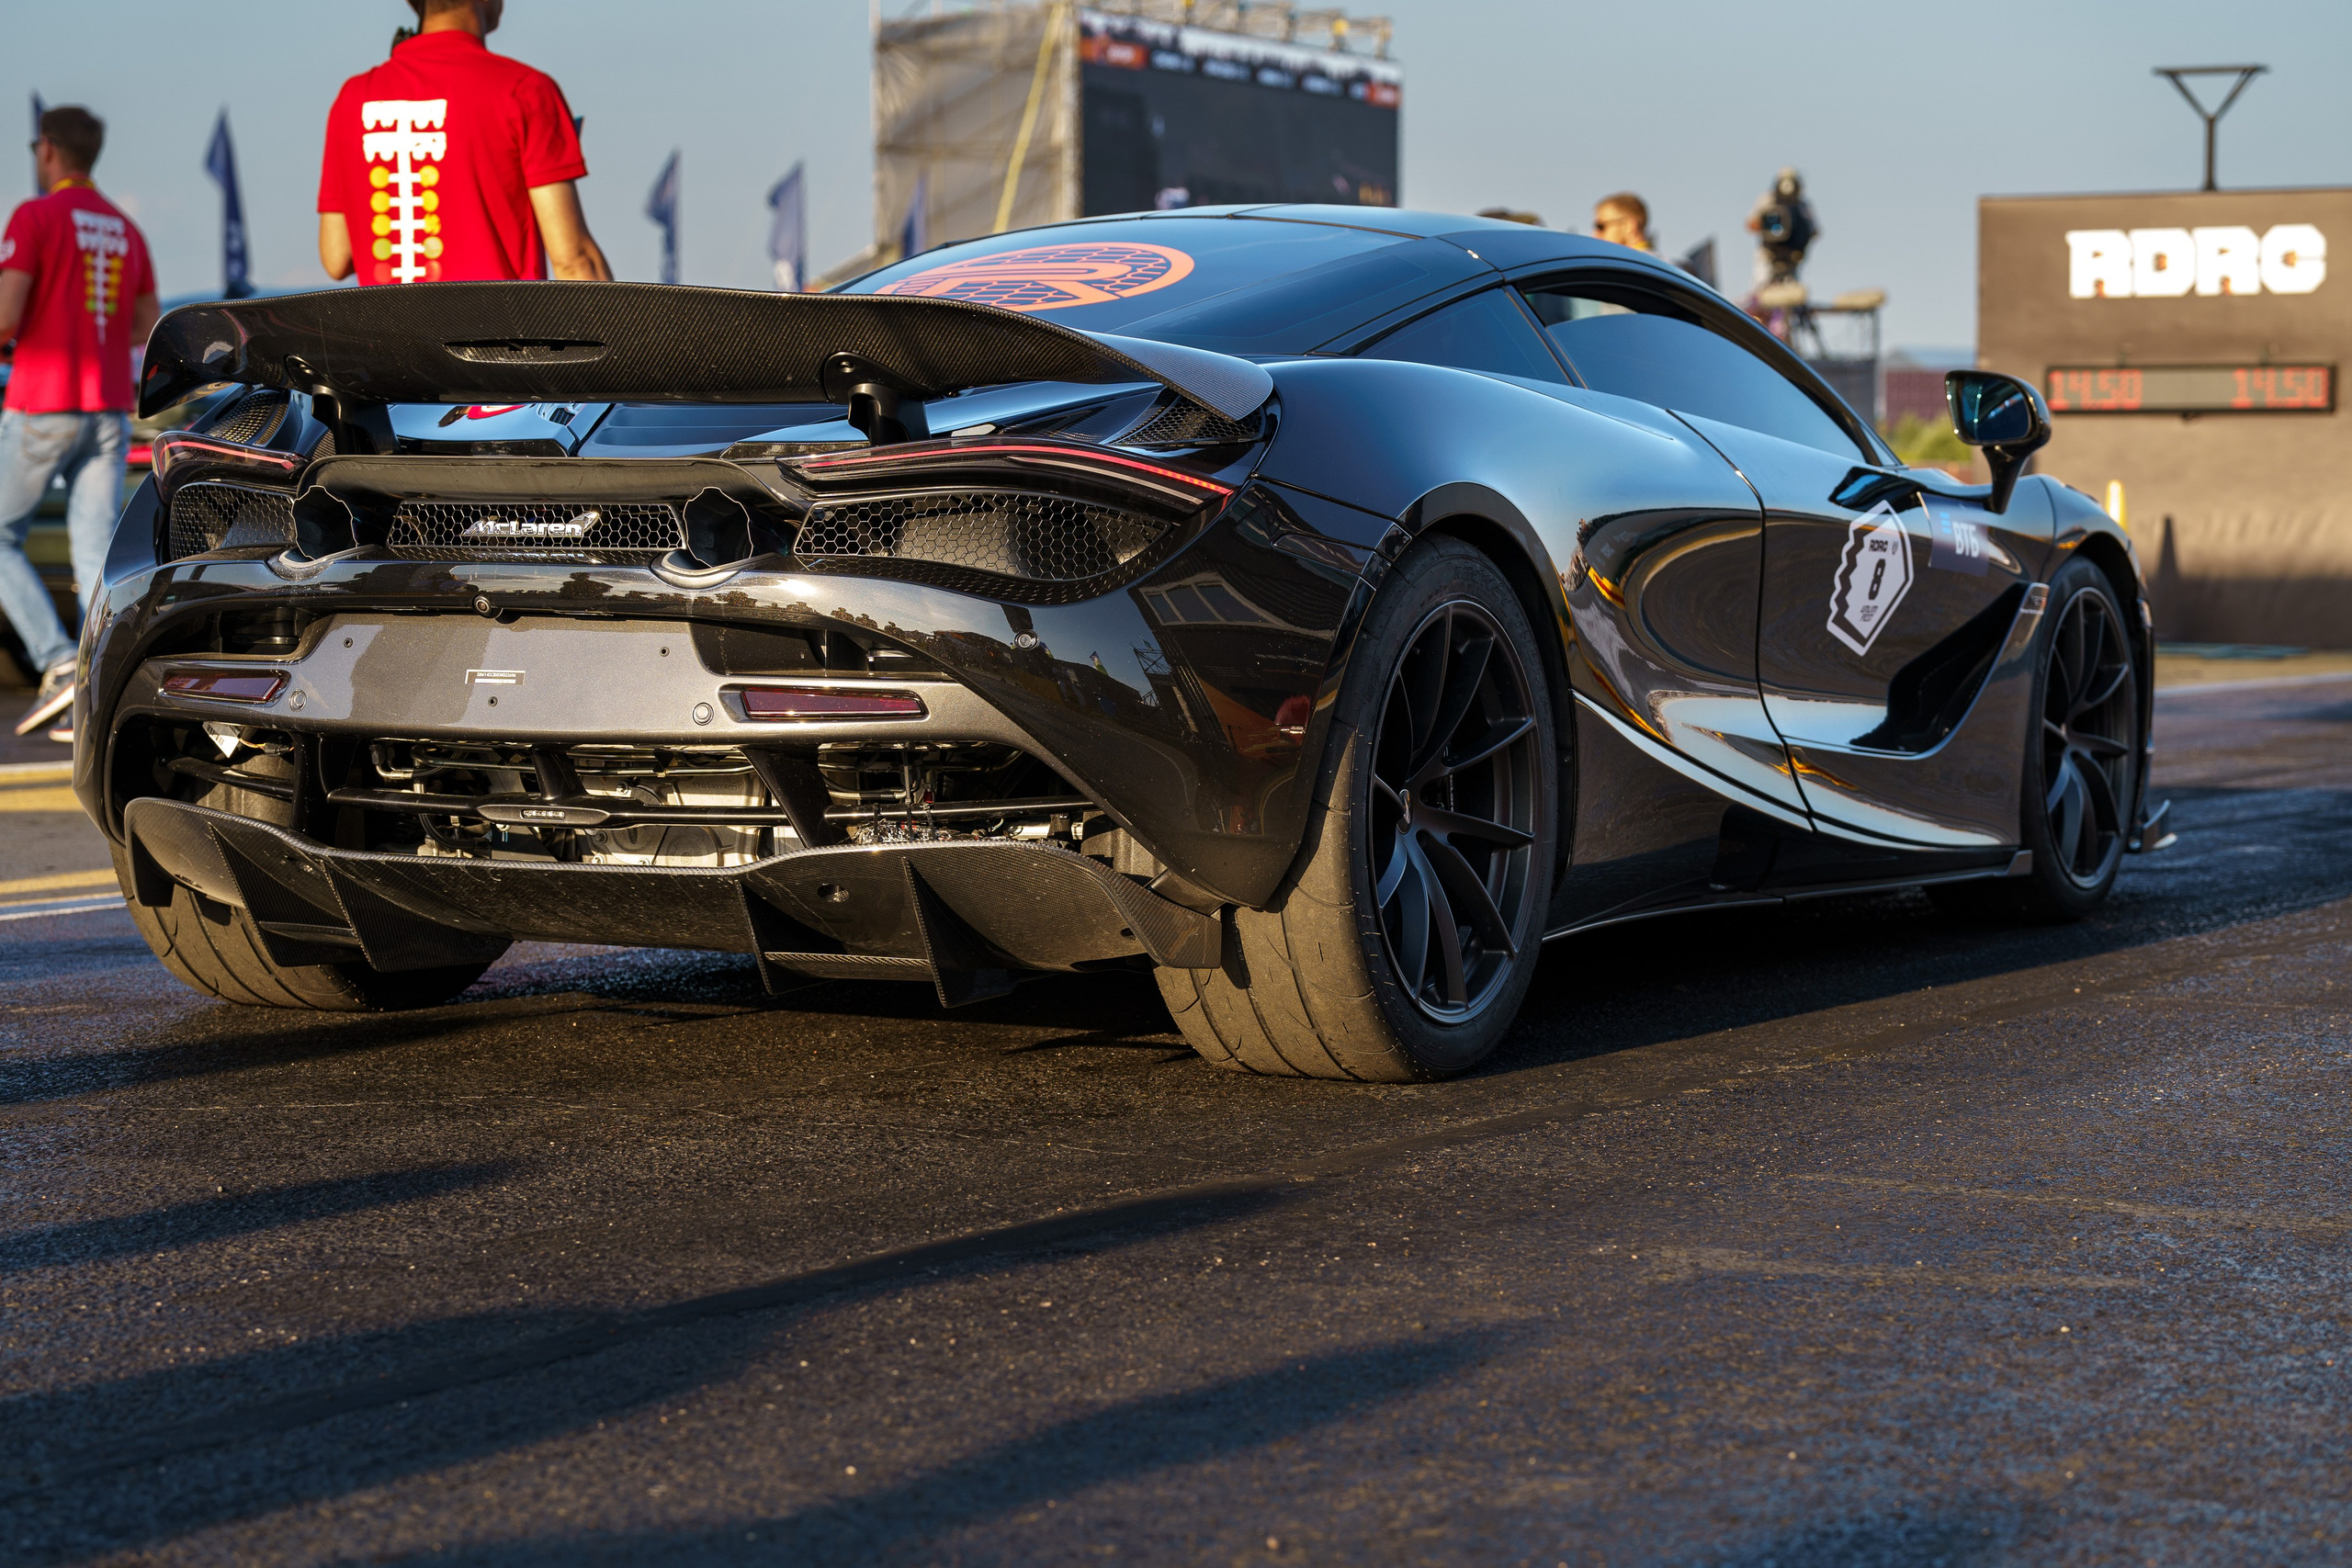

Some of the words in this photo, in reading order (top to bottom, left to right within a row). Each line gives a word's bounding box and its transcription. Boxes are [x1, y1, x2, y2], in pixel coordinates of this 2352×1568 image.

[2065, 223, 2327, 299] RDRC
[460, 520, 583, 538] McLaren
[1951, 521, 1980, 558] ВТБ
[1869, 539, 1888, 552] RDRC
